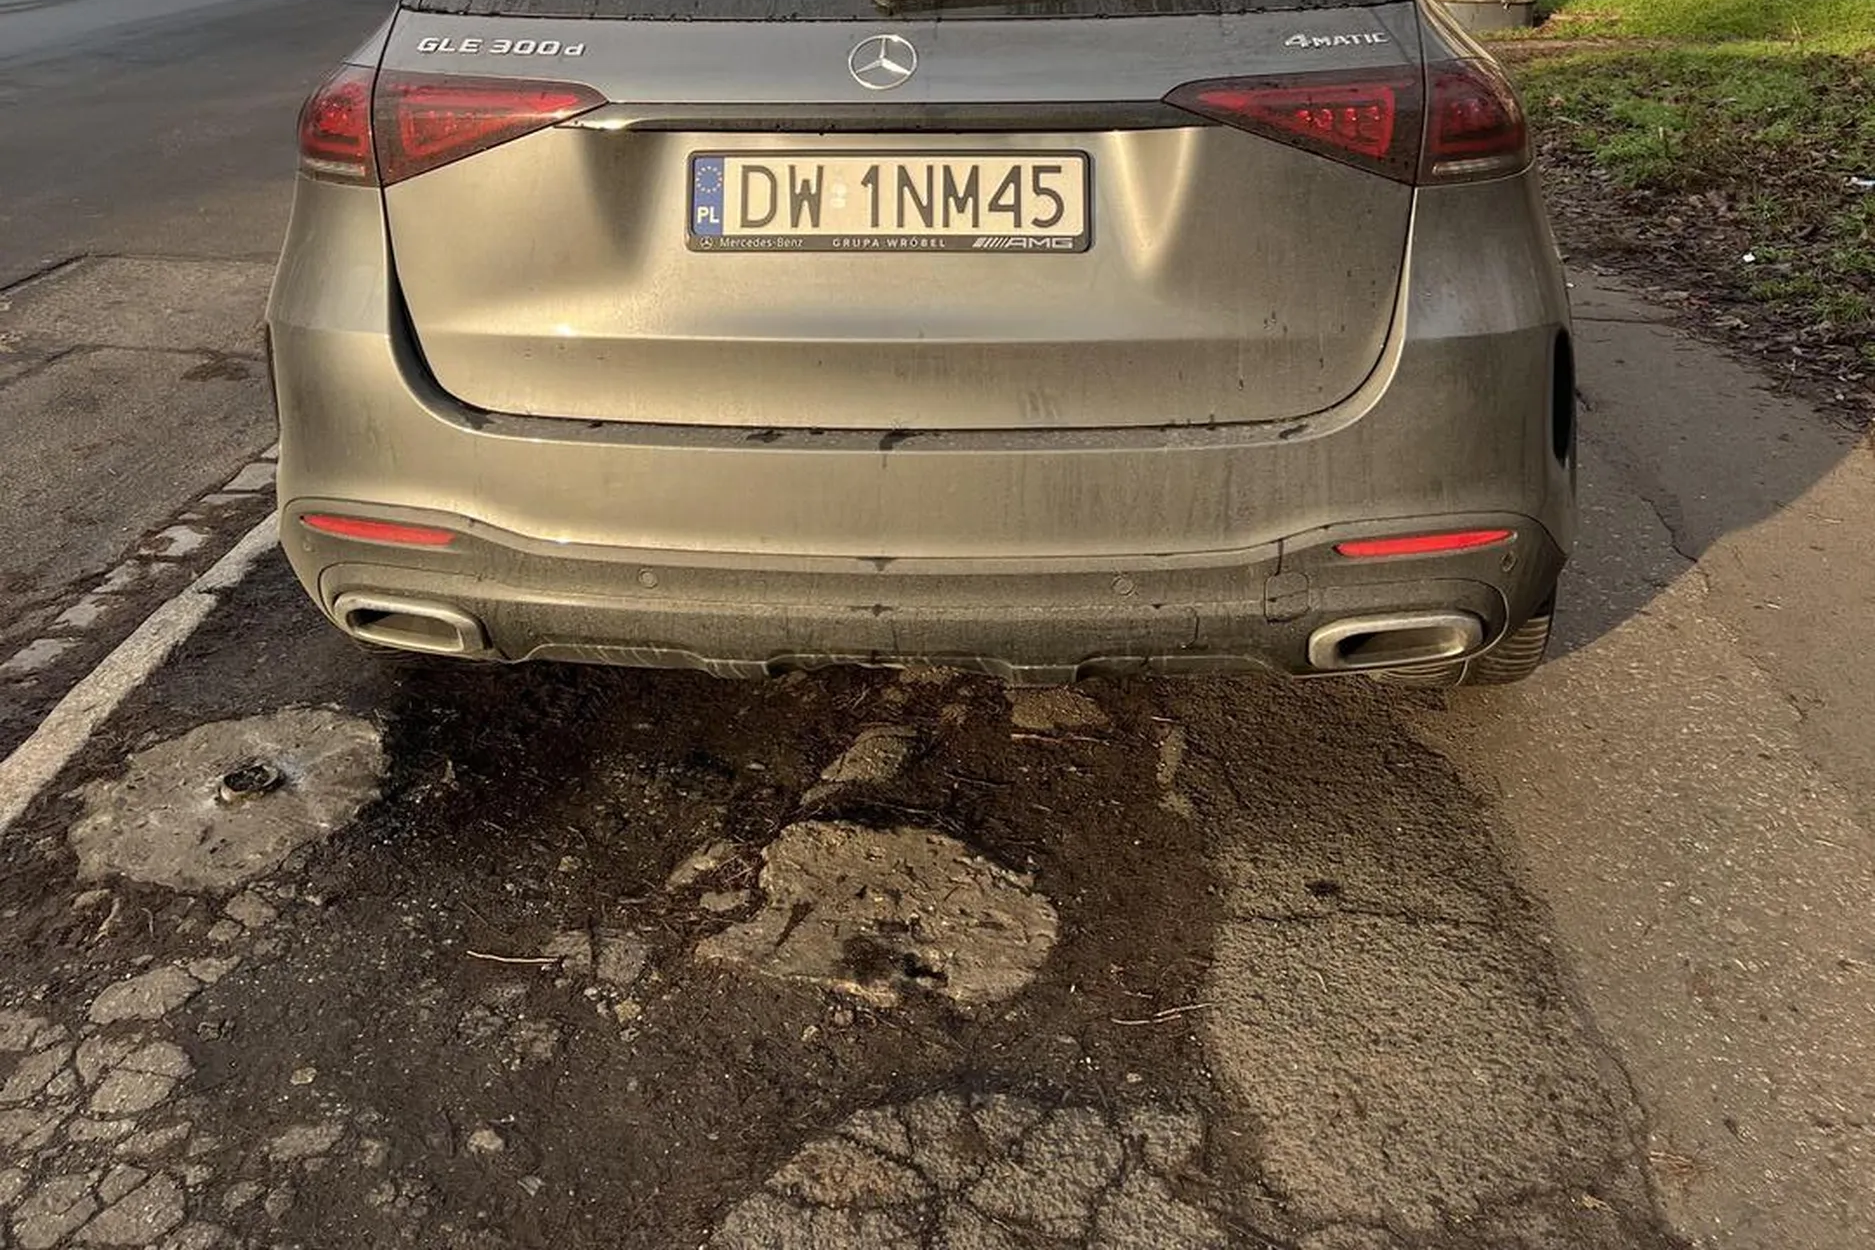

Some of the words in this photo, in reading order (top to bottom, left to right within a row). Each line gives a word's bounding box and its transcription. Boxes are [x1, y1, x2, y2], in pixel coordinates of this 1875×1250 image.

[417, 37, 482, 54] GLE
[489, 38, 586, 57] 300d
[1285, 33, 1390, 48] 4MATIC
[697, 206, 720, 224] PL
[741, 165, 824, 228] DW
[861, 165, 1065, 228] 1NM45
[720, 236, 804, 248] Mercedes-Benz
[832, 239, 880, 248] GRUPA
[887, 235, 946, 248] WRÓBEL
